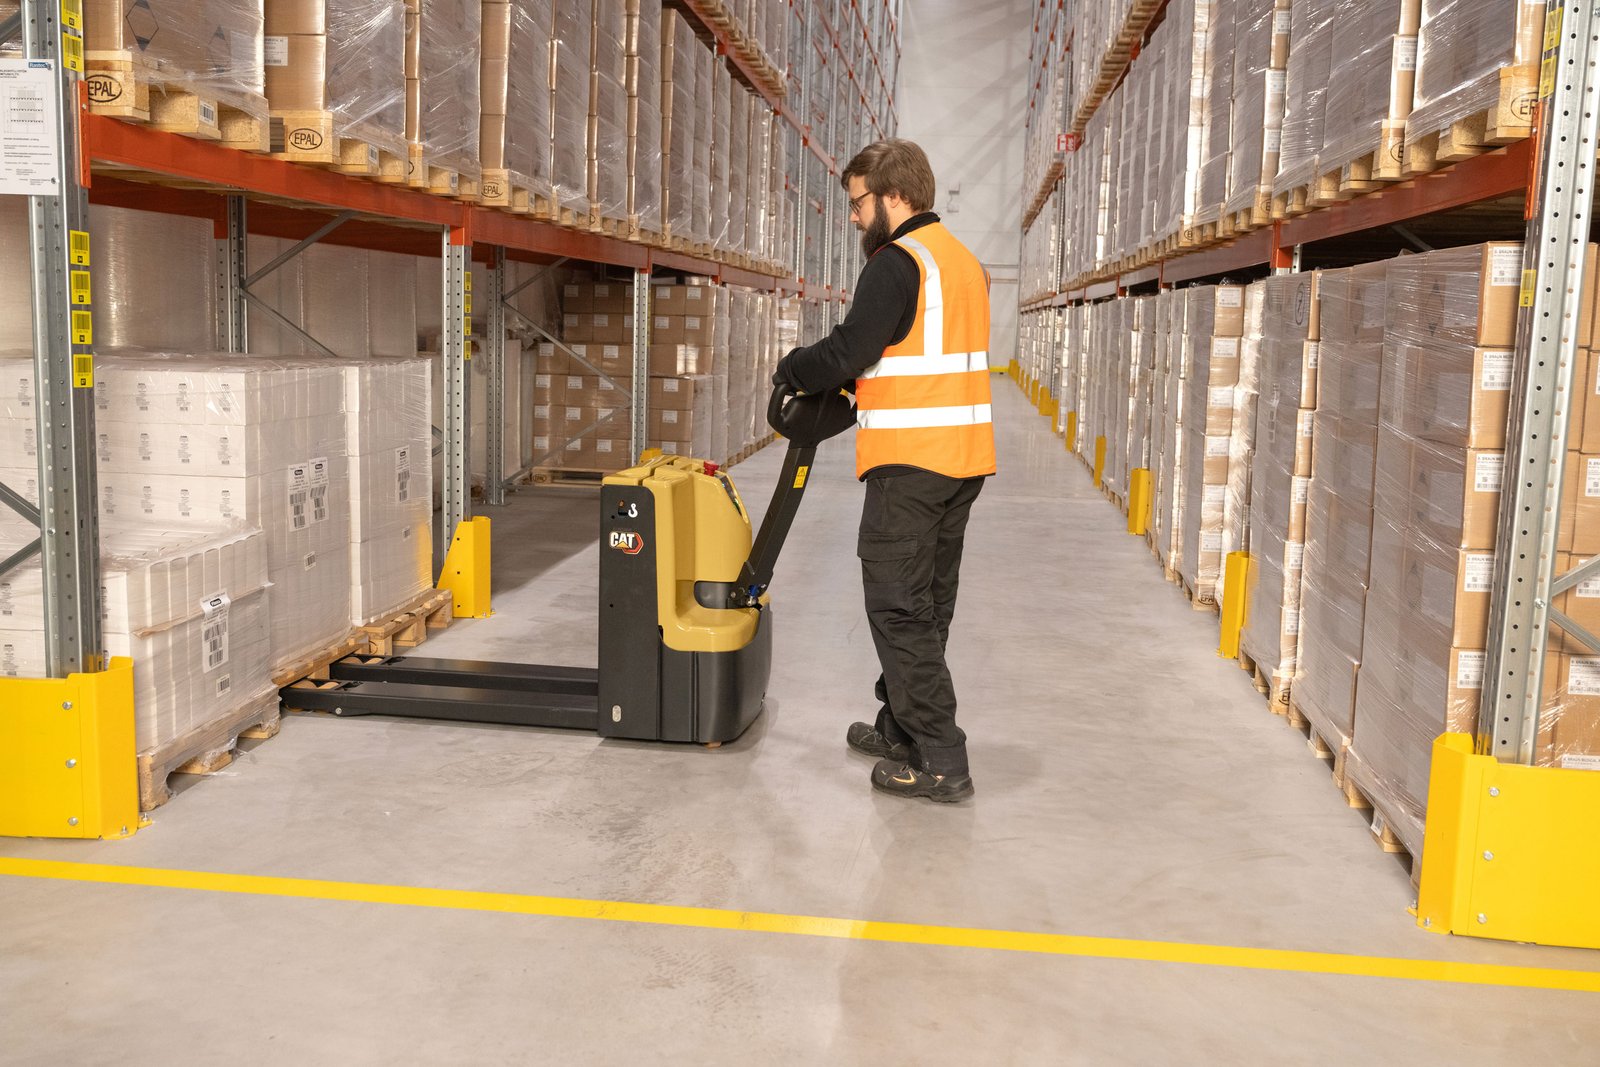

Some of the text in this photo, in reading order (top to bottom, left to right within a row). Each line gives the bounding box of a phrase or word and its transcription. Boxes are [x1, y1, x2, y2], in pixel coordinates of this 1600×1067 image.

[87, 80, 116, 97] EPAL
[294, 132, 317, 146] EPAL
[483, 184, 500, 195] EPAL
[610, 531, 635, 549] CAT
